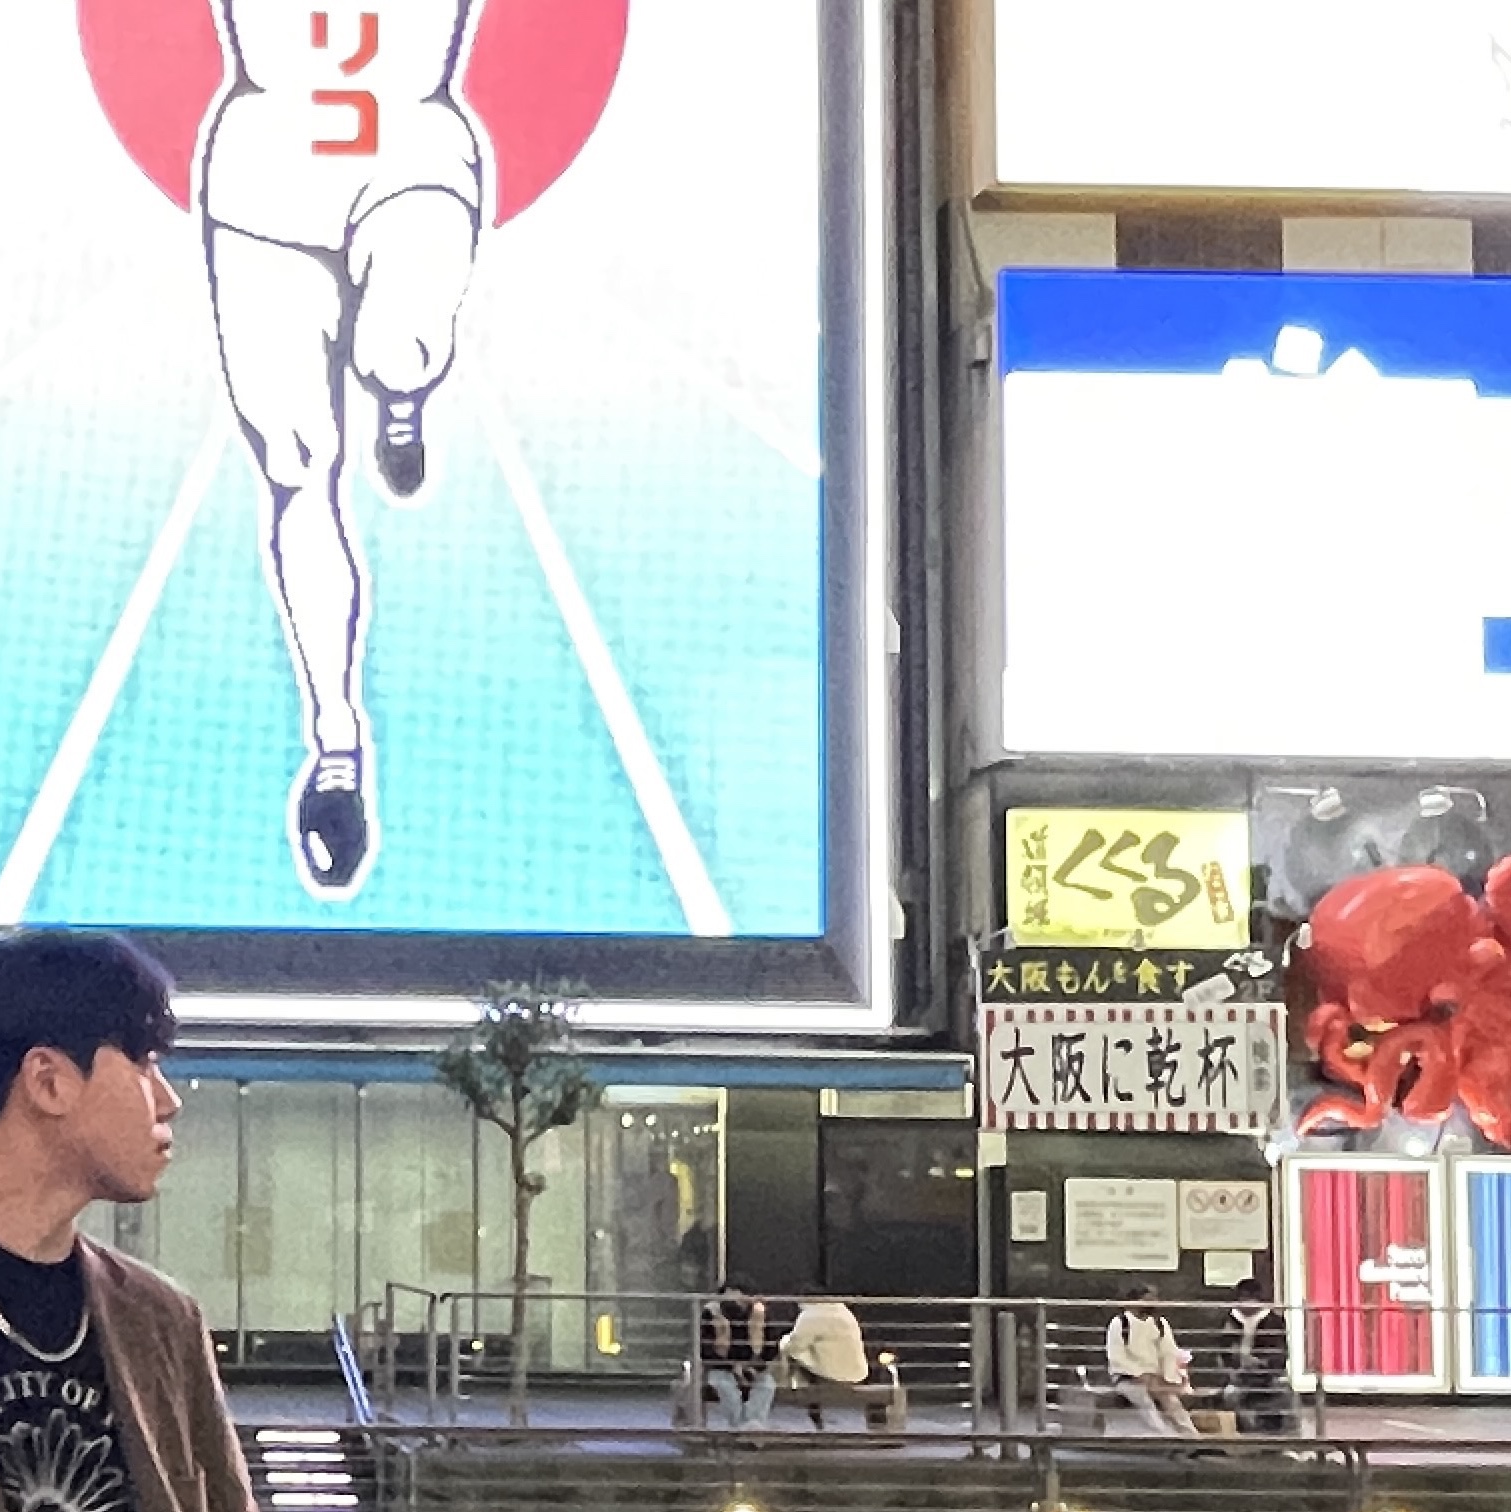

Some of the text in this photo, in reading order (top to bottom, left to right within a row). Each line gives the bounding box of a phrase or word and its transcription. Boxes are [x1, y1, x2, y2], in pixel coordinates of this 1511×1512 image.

[310, 12, 378, 155] リコ
[1052, 828, 1201, 927] くくる
[999, 1026, 1239, 1109] 大阪に乾杯
